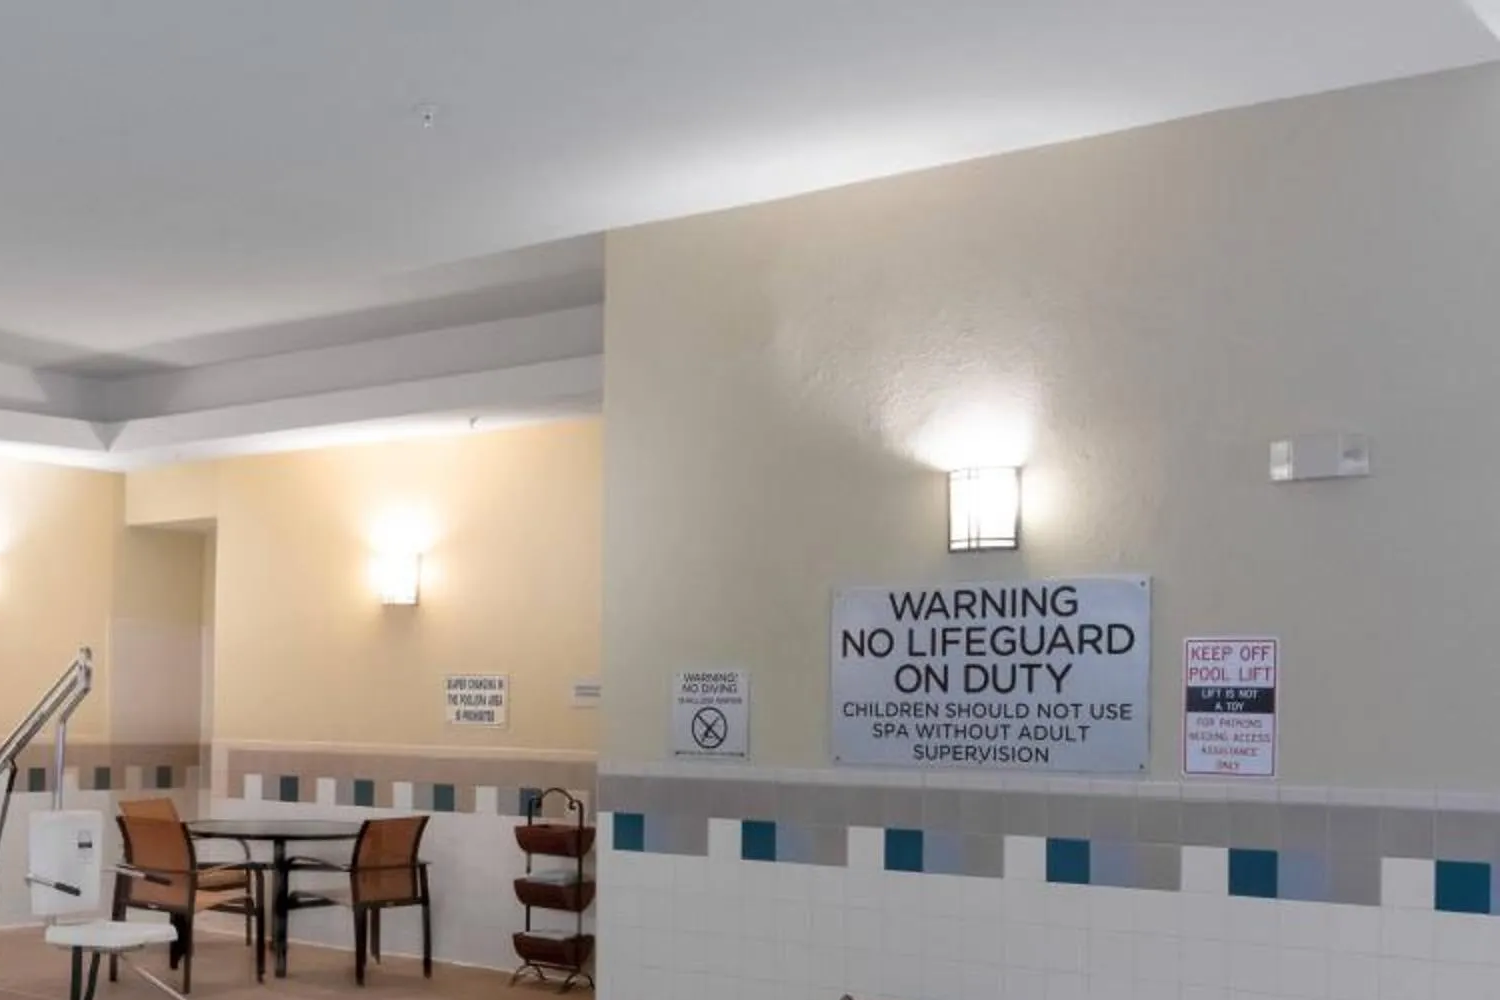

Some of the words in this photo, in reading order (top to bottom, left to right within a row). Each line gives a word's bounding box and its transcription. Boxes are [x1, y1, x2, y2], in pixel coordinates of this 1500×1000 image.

[889, 586, 1079, 621] WARNING
[842, 628, 895, 658] NO
[908, 623, 1135, 658] LIFEGUARD
[1190, 646, 1233, 661] KEEP
[1239, 645, 1272, 661] OFF
[894, 664, 949, 694] ON
[964, 663, 1073, 694] DUTY
[1189, 667, 1230, 682] POOL
[1238, 667, 1273, 682] LIFT
[1225, 689, 1235, 699] IS
[1239, 689, 1258, 699] NOT
[843, 702, 939, 719] CHILDREN
[945, 702, 1029, 720] SHOULD
[1037, 703, 1083, 720] NOT
[1089, 703, 1132, 721] USE
[1215, 701, 1223, 711] A
[872, 723, 908, 739] SPA
[915, 723, 1011, 740] WITHOUT
[1018, 725, 1091, 742] ADULT
[913, 743, 1049, 763] SUPERVISION
